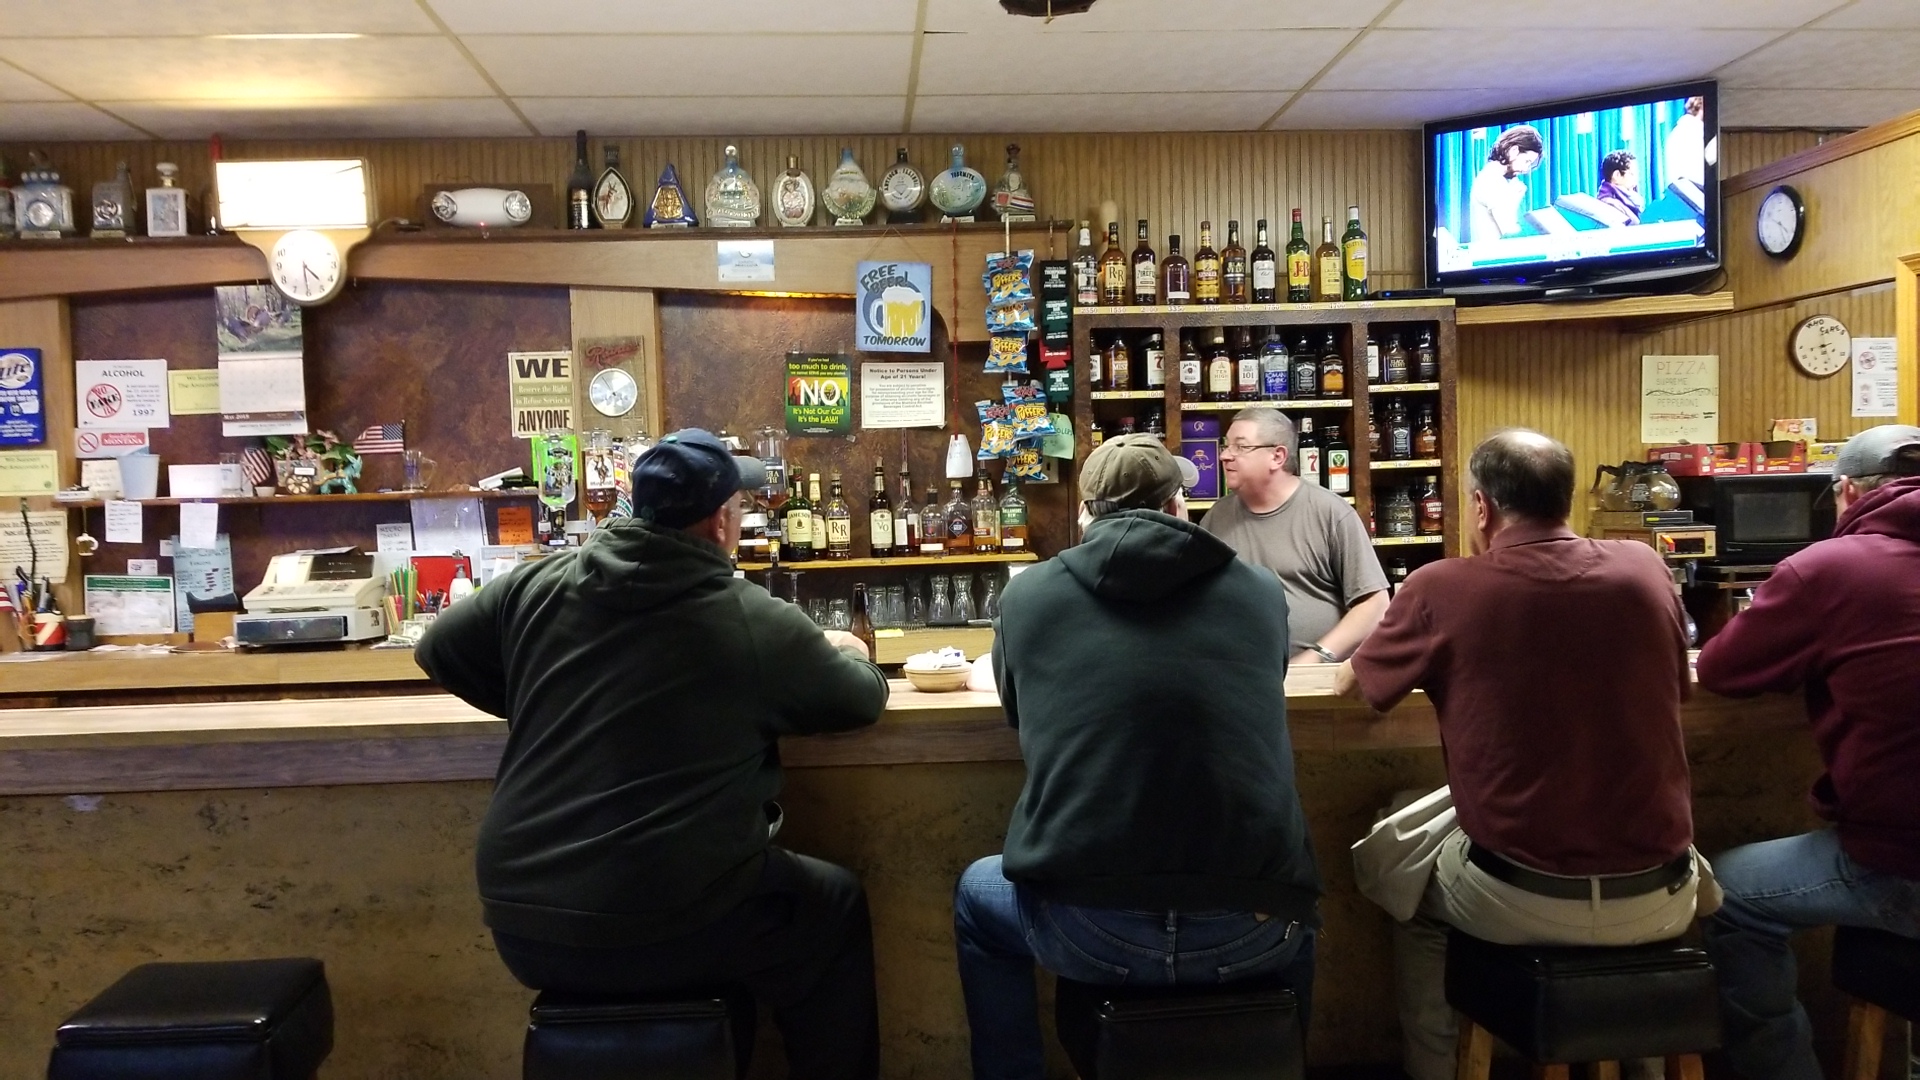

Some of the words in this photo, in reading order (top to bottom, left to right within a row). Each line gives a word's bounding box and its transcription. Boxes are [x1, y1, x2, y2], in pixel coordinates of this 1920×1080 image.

[276, 262, 282, 271] 9
[281, 276, 287, 285] 8
[328, 274, 334, 282] 4
[860, 264, 898, 292] FREE
[870, 271, 908, 294] BEER!
[292, 286, 298, 294] 7
[1806, 319, 1824, 328] WHO
[1820, 325, 1845, 336] CARES
[863, 336, 926, 346] TOMORROW
[515, 358, 569, 378] WE
[1656, 361, 1708, 375] PIZZA
[552, 384, 568, 393] Right
[1656, 378, 1688, 386] SUPREME
[800, 380, 840, 406] NO
[90, 393, 121, 410] FAKE
[1015, 405, 1047, 421] PUFFERS
[518, 410, 570, 431] ANYONE
[985, 426, 1014, 442] PUFERS
[1011, 452, 1038, 465] UFFERS
[1308, 454, 1318, 472] 7
